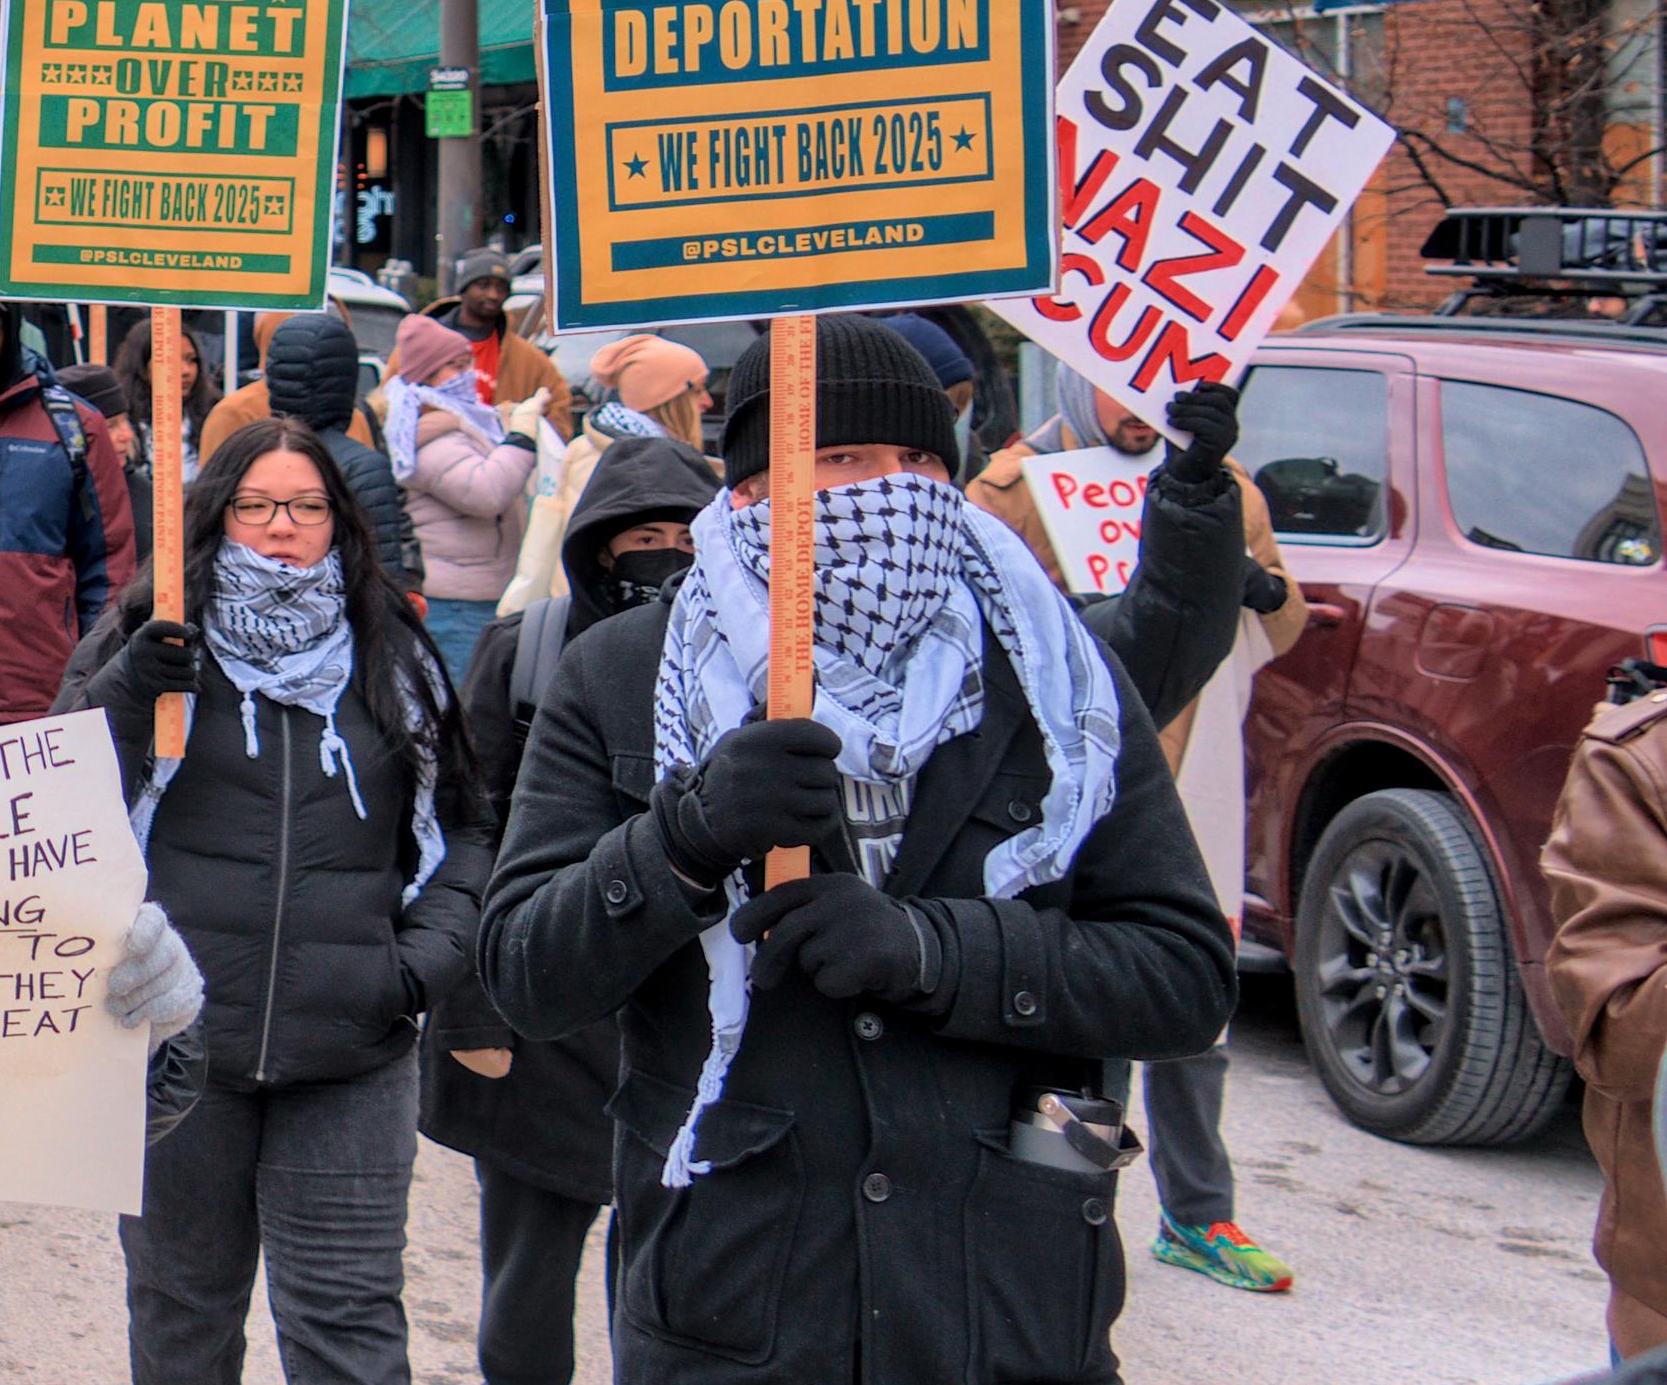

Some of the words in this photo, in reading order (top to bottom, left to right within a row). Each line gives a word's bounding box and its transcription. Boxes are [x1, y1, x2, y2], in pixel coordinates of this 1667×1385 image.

[51, 0, 303, 52] PLANET
[116, 58, 229, 97] OVER
[66, 98, 277, 150] PROFIT
[1083, 43, 1339, 254] SHIT
[658, 130, 699, 192] WE
[709, 124, 787, 188] FIGHT
[798, 117, 865, 181] BACK
[873, 111, 943, 175] 2025
[70, 177, 95, 217] WE
[102, 178, 155, 220] FIGHT
[160, 181, 208, 222] BACK
[214, 184, 261, 224] 2025
[682, 223, 925, 260] @PSLCLEVELAND
[1058, 115, 1280, 342] NAZI
[79, 249, 243, 270] @PSLCLEVELAND
[1031, 251, 1232, 394] CUM
[799, 339, 812, 374] THE
[799, 376, 811, 399] OF
[798, 402, 811, 452] HOME
[796, 497, 812, 564] DEPOT
[796, 568, 810, 629] HOME
[795, 633, 810, 675] THE
[9, 829, 97, 881] HAVE
[17, 934, 95, 960] TO
[2, 1005, 93, 1038] EAT
